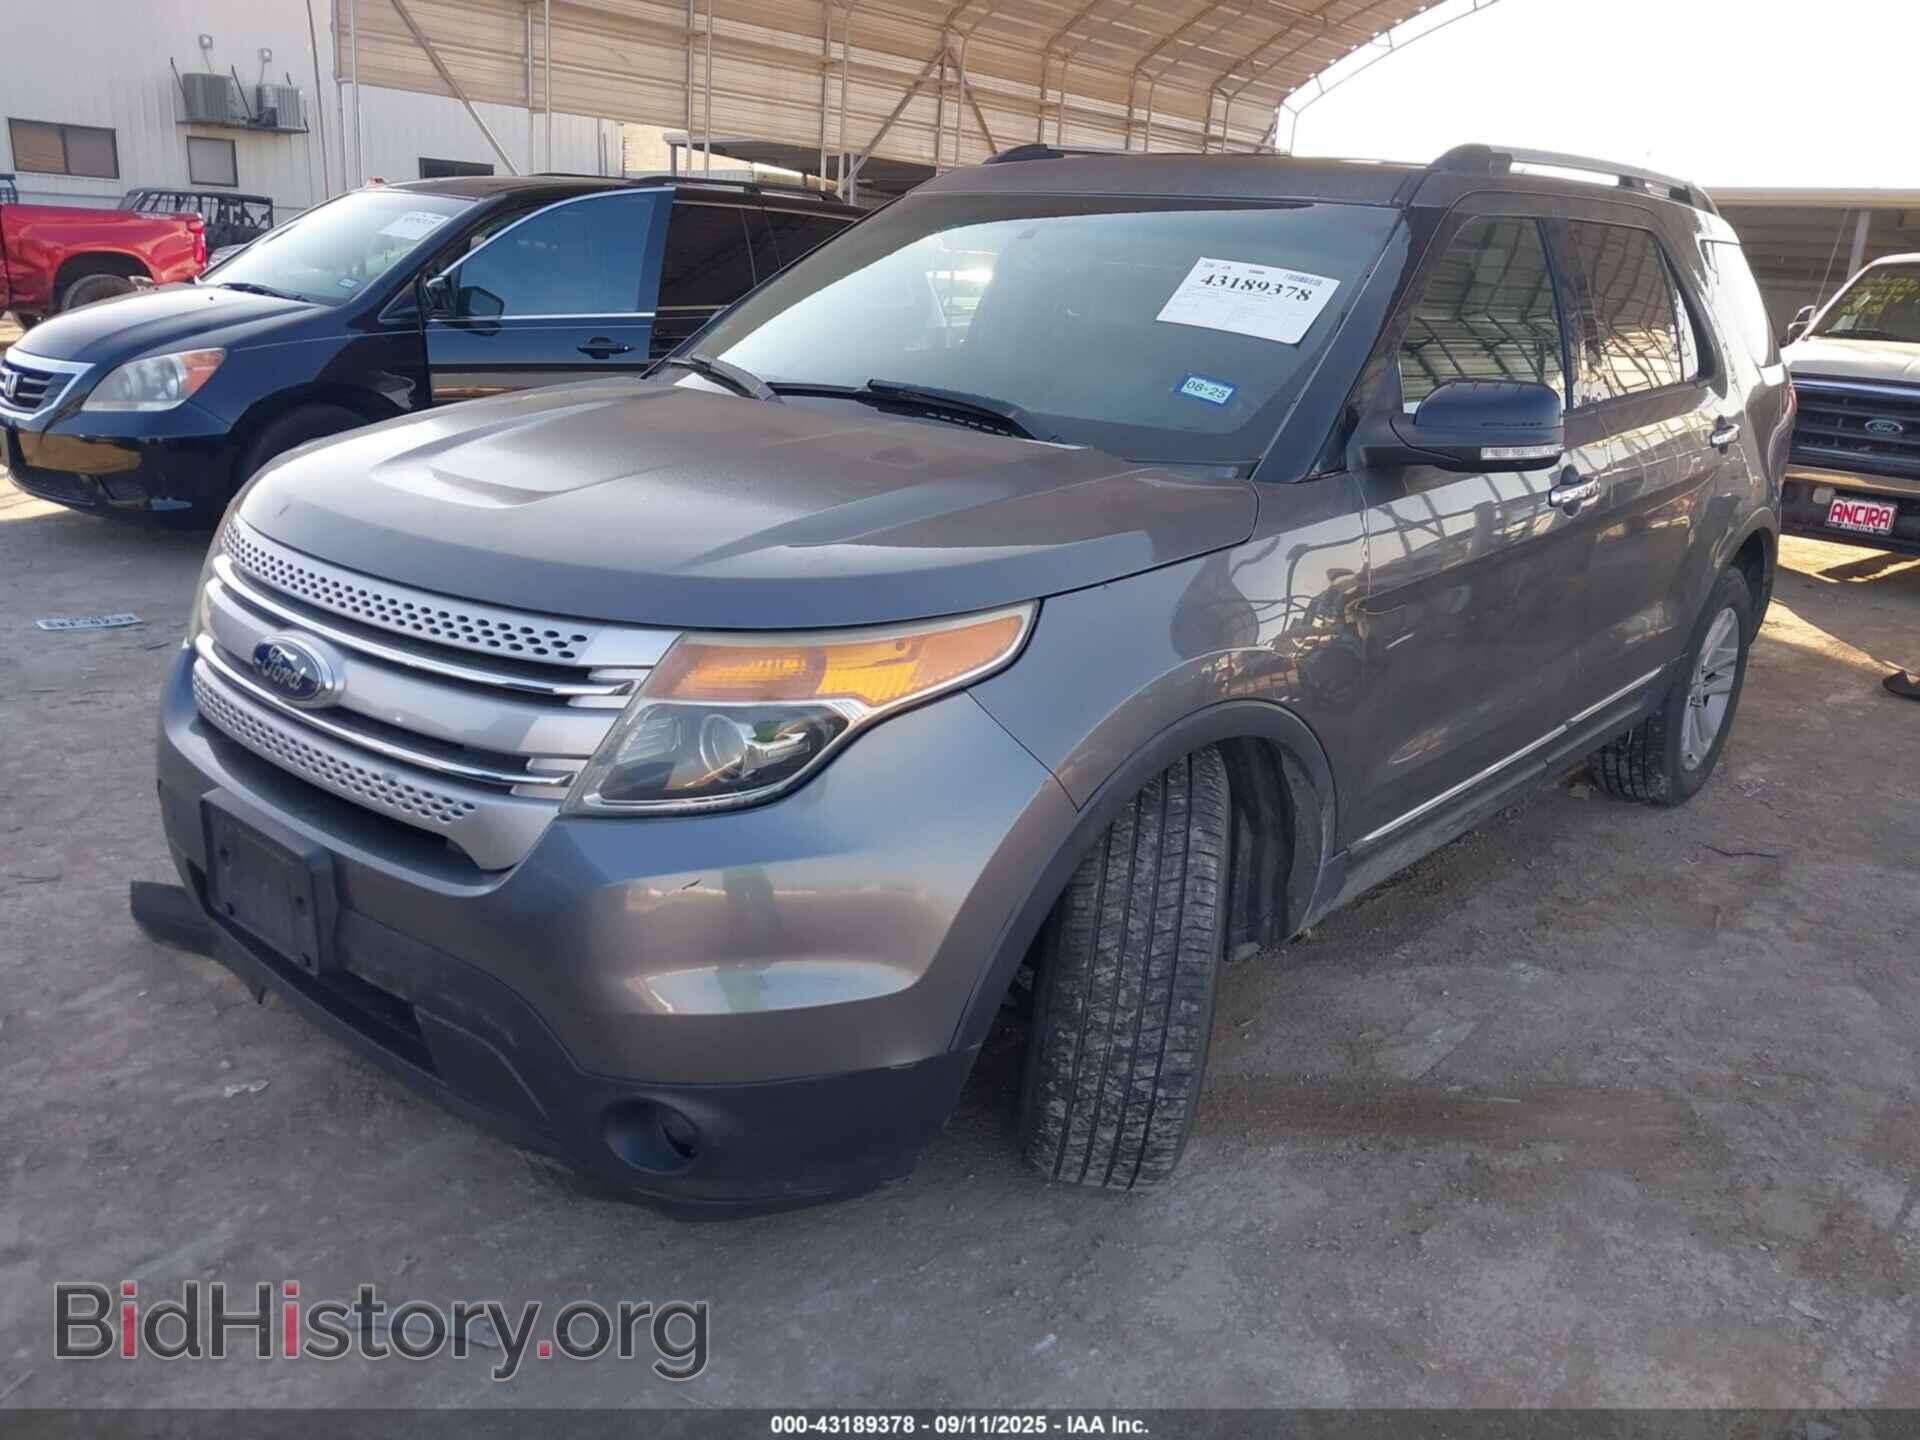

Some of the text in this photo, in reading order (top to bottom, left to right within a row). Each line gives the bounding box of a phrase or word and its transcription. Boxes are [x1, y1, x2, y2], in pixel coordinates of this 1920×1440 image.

[1200, 274, 1312, 302] 43189378
[1831, 503, 1890, 528] ANCIRA
[262, 645, 306, 690] Ford
